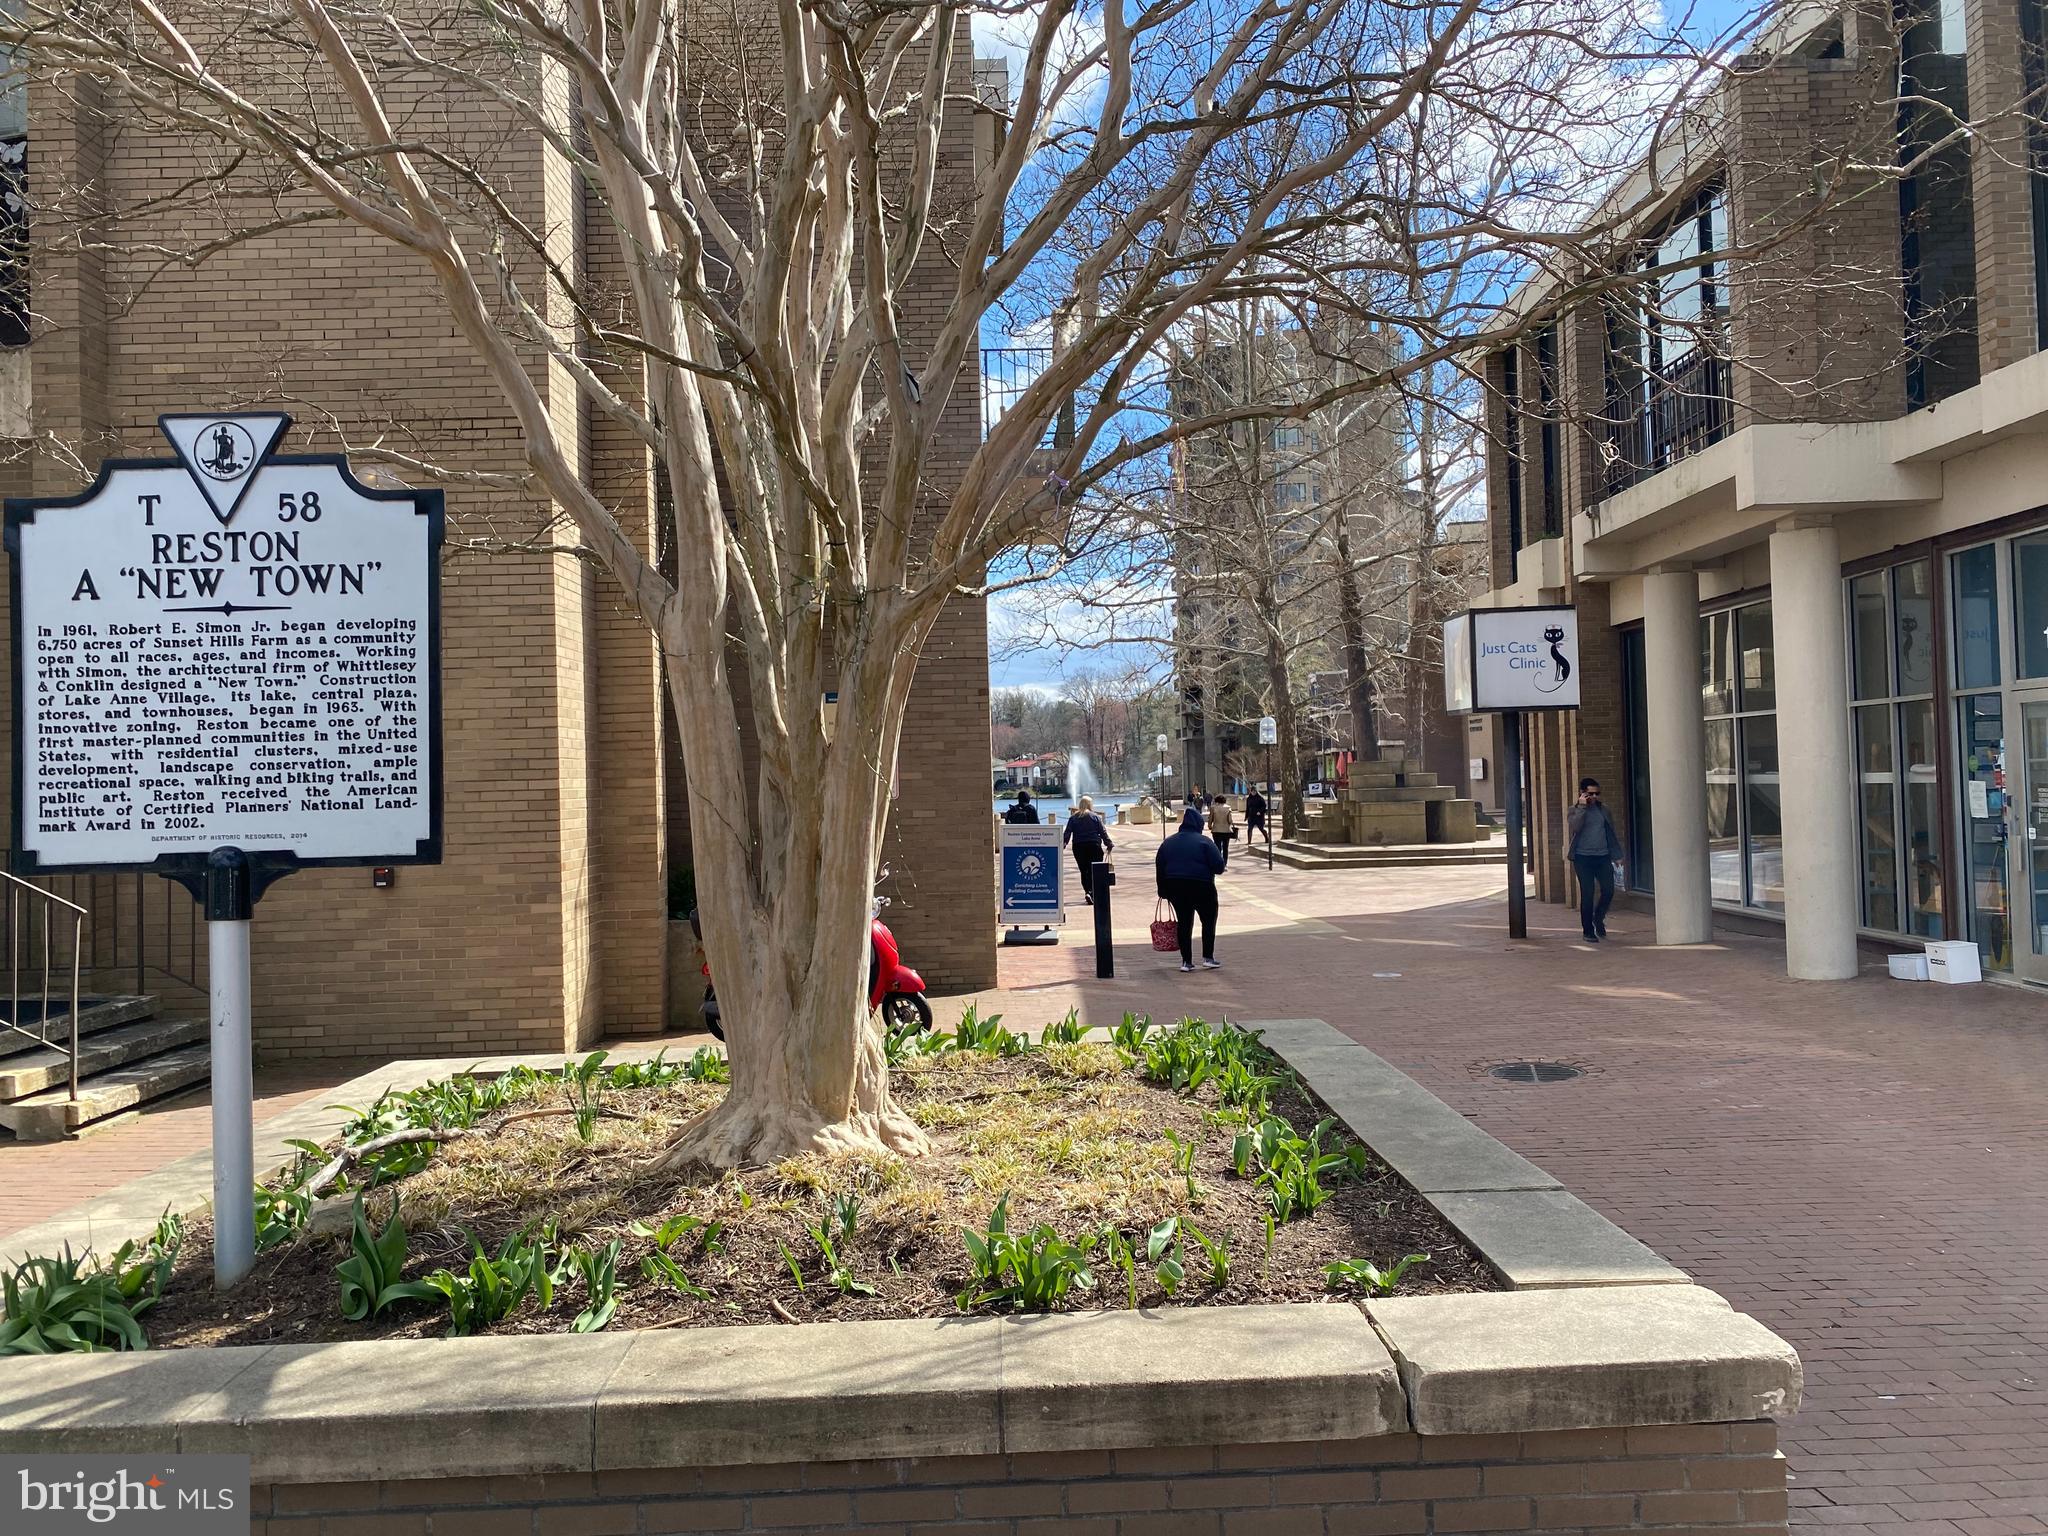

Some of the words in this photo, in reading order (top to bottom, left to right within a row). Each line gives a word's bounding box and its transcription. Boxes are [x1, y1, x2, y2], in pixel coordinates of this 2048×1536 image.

[138, 494, 161, 526] T
[278, 491, 322, 522] 58
[152, 531, 300, 564] RESTON
[71, 569, 101, 600] A
[119, 566, 225, 599] “NEW
[249, 561, 383, 597] TOWN”
[38, 626, 52, 637] In
[63, 625, 97, 638] 1961,
[109, 624, 161, 636] Robert
[172, 623, 186, 634] E.
[195, 622, 241, 634] Simon
[251, 621, 270, 632] Jr.
[280, 620, 325, 634] began
[336, 618, 416, 633] developing
[38, 639, 77, 652] 6,750
[82, 641, 122, 650] acres
[129, 638, 146, 649] of
[153, 637, 203, 648] Sunset
[209, 636, 244, 647] Hills
[251, 635, 288, 646] Farm
[295, 637, 310, 645] as
[318, 636, 327, 645] a
[333, 632, 416, 647] community
[1481, 642, 1506, 657] Just
[1508, 641, 1537, 653] Cats
[38, 656, 74, 668] open
[84, 653, 100, 664] to
[110, 652, 129, 663] all
[137, 654, 182, 664] races,
[192, 652, 230, 664] ages,
[239, 649, 266, 660] and
[275, 647, 340, 659] incomes.
[356, 646, 416, 660] Working
[1509, 657, 1546, 669] Clinic
[38, 667, 70, 679] with
[75, 666, 127, 679] Simon,
[136, 665, 161, 677] the
[168, 663, 266, 676] architectural
[272, 662, 305, 673] firm
[313, 661, 329, 672] of
[337, 659, 416, 674] Whittlesey
[38, 682, 48, 693] &
[55, 680, 114, 692] Conklin
[120, 679, 186, 693] designed
[193, 681, 202, 689] a
[319, 673, 416, 686] Construction
[38, 696, 55, 707] of
[65, 694, 100, 706] Lake
[109, 693, 147, 705] Anne
[158, 692, 215, 706] Village,
[231, 691, 250, 702] its
[261, 690, 296, 703] lake,
[311, 688, 363, 700] central
[373, 687, 417, 701] plaza,
[38, 709, 90, 722] stores,
[104, 708, 131, 719] and
[141, 705, 233, 719] townhouses,
[249, 704, 294, 718] began
[303, 703, 317, 714] in
[327, 702, 363, 714] 1963.
[380, 701, 416, 712] With
[38, 722, 117, 735] innovative
[126, 720, 181, 735] zoning,
[196, 719, 248, 731] Reston
[260, 717, 316, 729] became
[328, 719, 354, 727] one
[364, 715, 381, 726] of
[391, 715, 417, 726] the
[38, 737, 73, 748] first
[82, 734, 201, 750] master-planned
[210, 731, 305, 744] communities
[314, 731, 328, 742] in
[336, 730, 360, 741] the
[367, 728, 417, 740] United
[38, 750, 91, 764] States,
[110, 749, 143, 761] with
[157, 747, 238, 759] residential
[254, 745, 318, 758] clusters,
[337, 742, 417, 755] mixed-use
[38, 763, 138, 779] development,
[160, 761, 233, 776] landscape
[249, 758, 351, 772] conservation,
[373, 756, 417, 770] ample
[38, 777, 131, 790] recreational
[138, 778, 184, 790] space,
[194, 774, 250, 789] walking
[255, 773, 282, 785] and
[286, 772, 334, 786] biking
[339, 771, 384, 784] trails,
[390, 770, 417, 781] and
[38, 792, 85, 807] public
[102, 791, 131, 802] art.
[153, 789, 204, 801] Reston
[221, 787, 287, 799] received
[305, 786, 330, 797] the
[346, 783, 417, 796] American
[38, 806, 104, 818] Institute
[115, 805, 133, 816] of
[143, 803, 214, 815] Certified
[301, 799, 364, 811] National
[375, 797, 417, 809] Land-
[38, 820, 76, 832] mark
[85, 819, 131, 831] Award
[140, 818, 155, 829] in
[164, 817, 205, 829] 2002.
